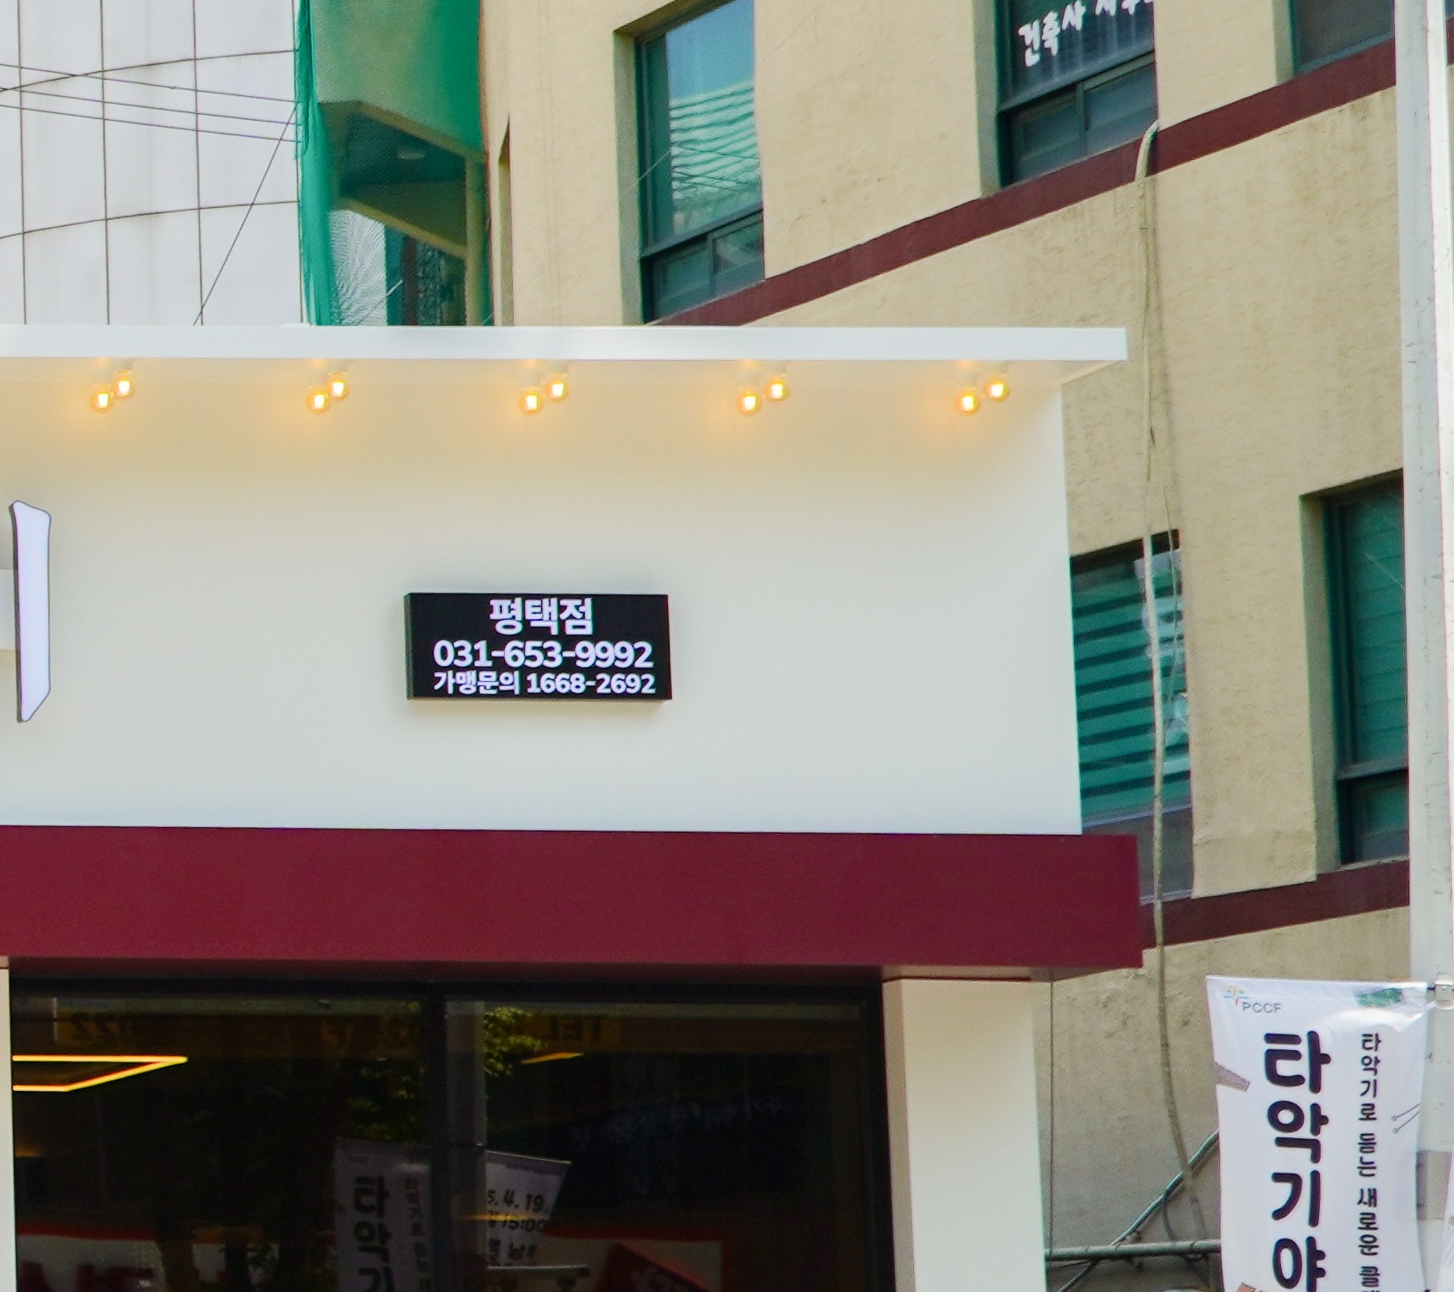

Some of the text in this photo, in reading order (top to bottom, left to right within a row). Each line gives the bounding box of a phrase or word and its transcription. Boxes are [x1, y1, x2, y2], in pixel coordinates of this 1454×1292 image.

[1018, 0, 1086, 67] 건축사
[489, 598, 593, 635] 평택점
[433, 640, 654, 668] 031-653-9992
[433, 671, 656, 695] 가맹문의 1668-2692
[1242, 1001, 1282, 1014] PCCF
[1359, 1032, 1382, 1123] 타악기로
[1357, 1187, 1379, 1257] 새로운
